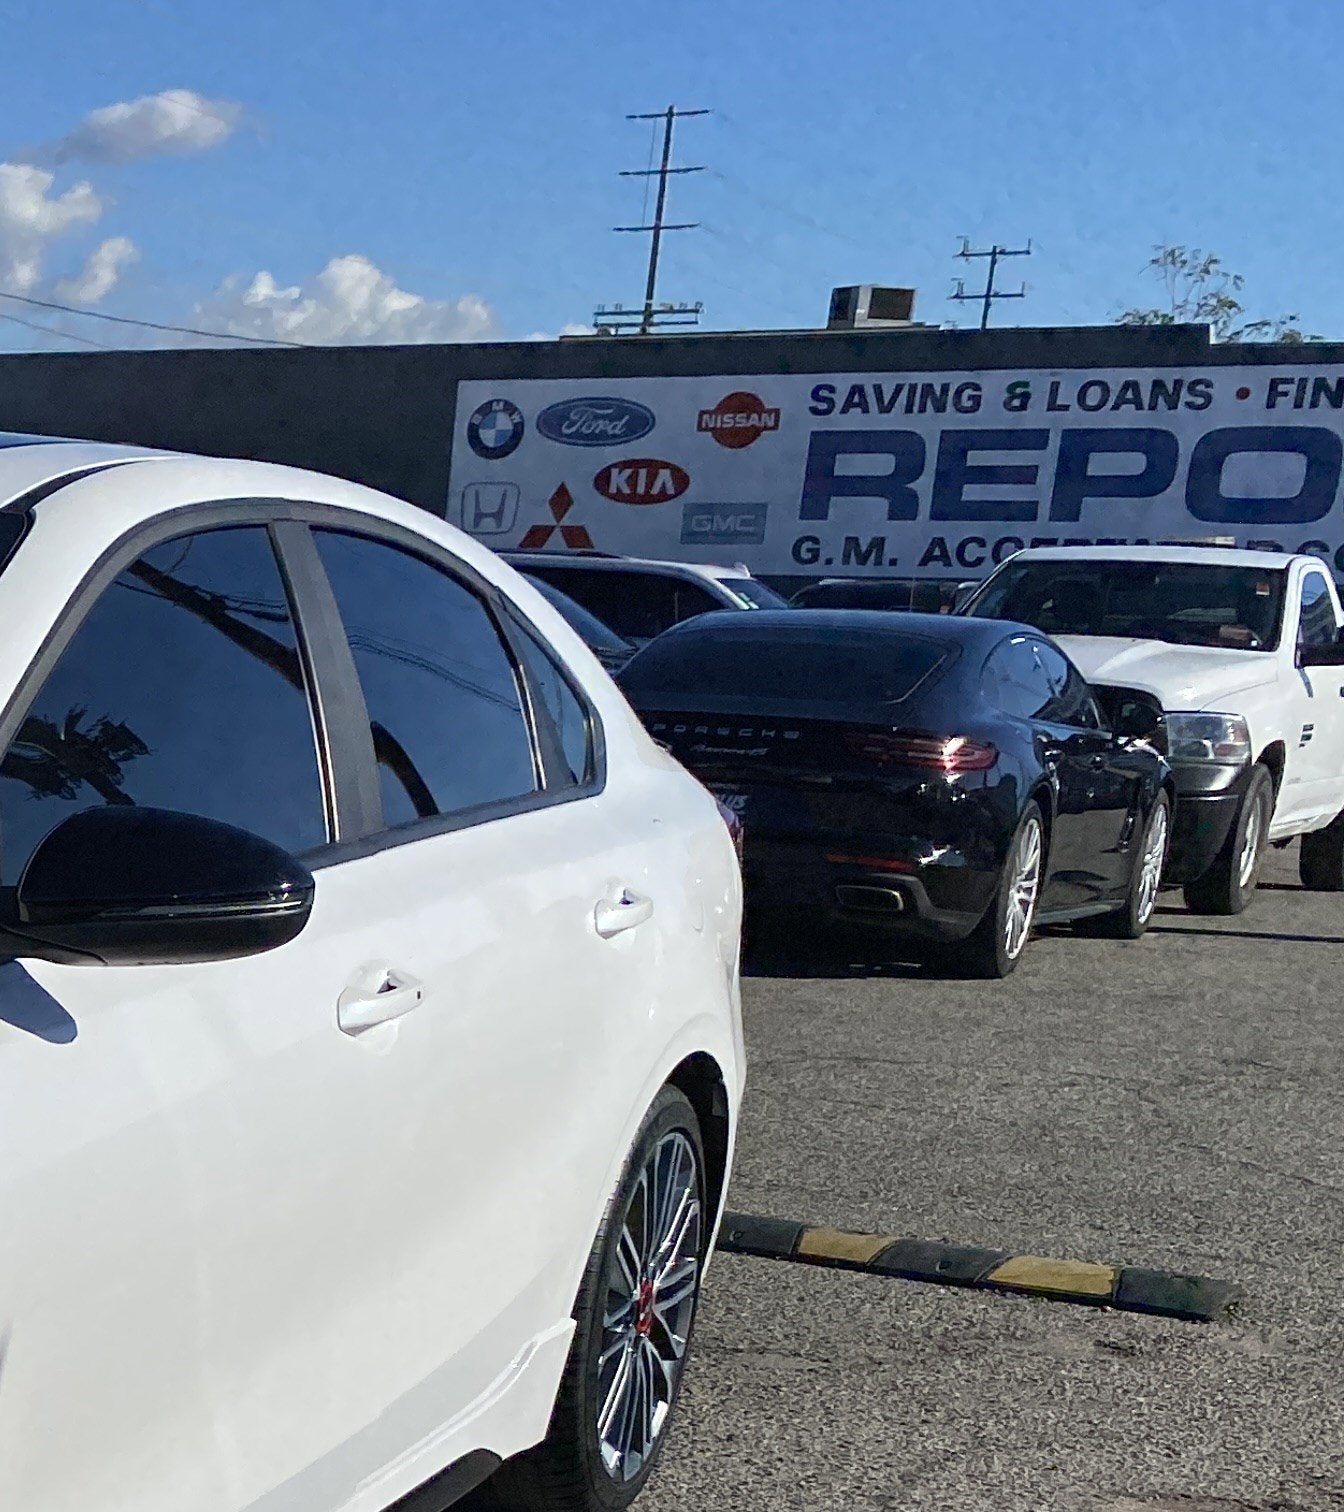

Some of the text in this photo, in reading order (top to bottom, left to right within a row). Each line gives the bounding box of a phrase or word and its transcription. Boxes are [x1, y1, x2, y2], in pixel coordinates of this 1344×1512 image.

[808, 382, 982, 416] SAVING
[1003, 380, 1032, 411] &
[1046, 378, 1213, 412] LOANS
[563, 405, 632, 434] Ford
[701, 411, 775, 428] NISSAN
[608, 468, 675, 495] KIA
[799, 426, 1343, 524] REPO
[691, 515, 755, 532] GMC
[791, 536, 898, 567] G.M.
[652, 723, 800, 739] PORSCHE
